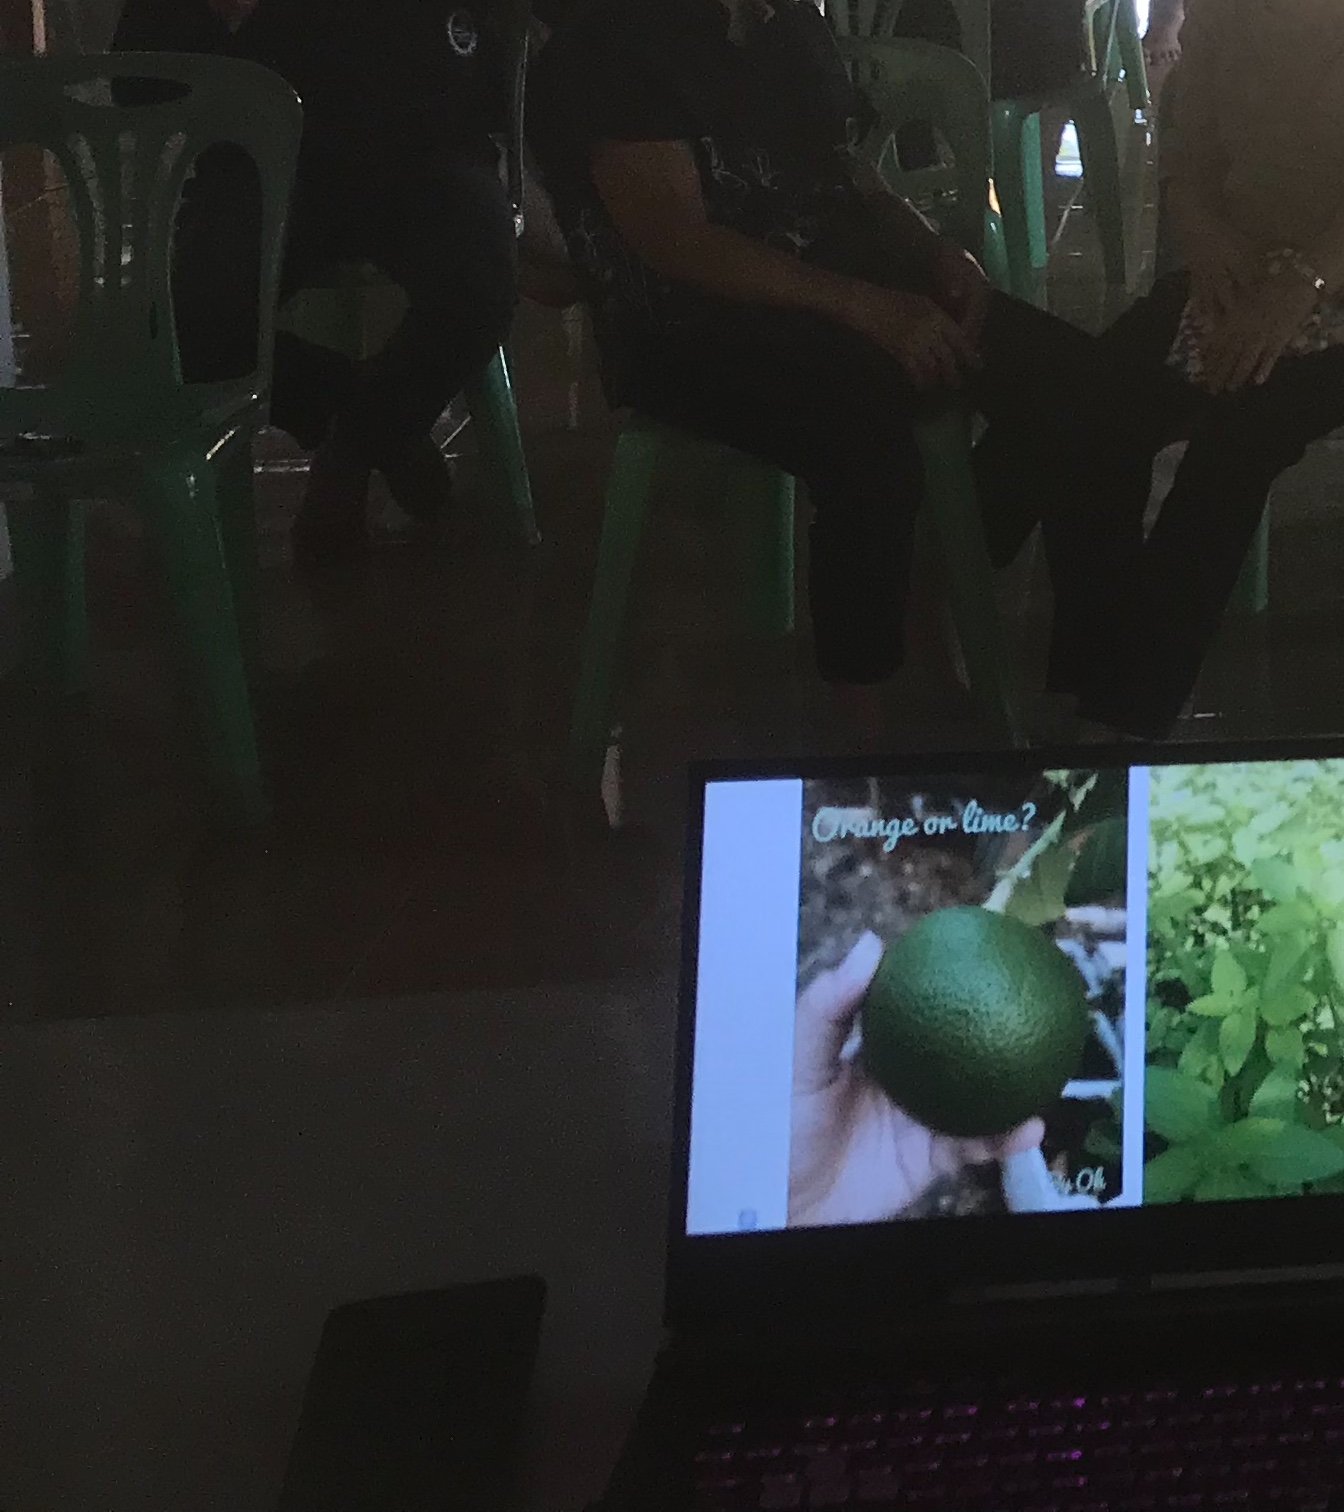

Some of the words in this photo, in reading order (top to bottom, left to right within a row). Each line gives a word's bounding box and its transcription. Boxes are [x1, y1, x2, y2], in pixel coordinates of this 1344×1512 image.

[811, 806, 919, 854] Orange
[923, 815, 958, 835] or
[962, 797, 1036, 834] lime?
